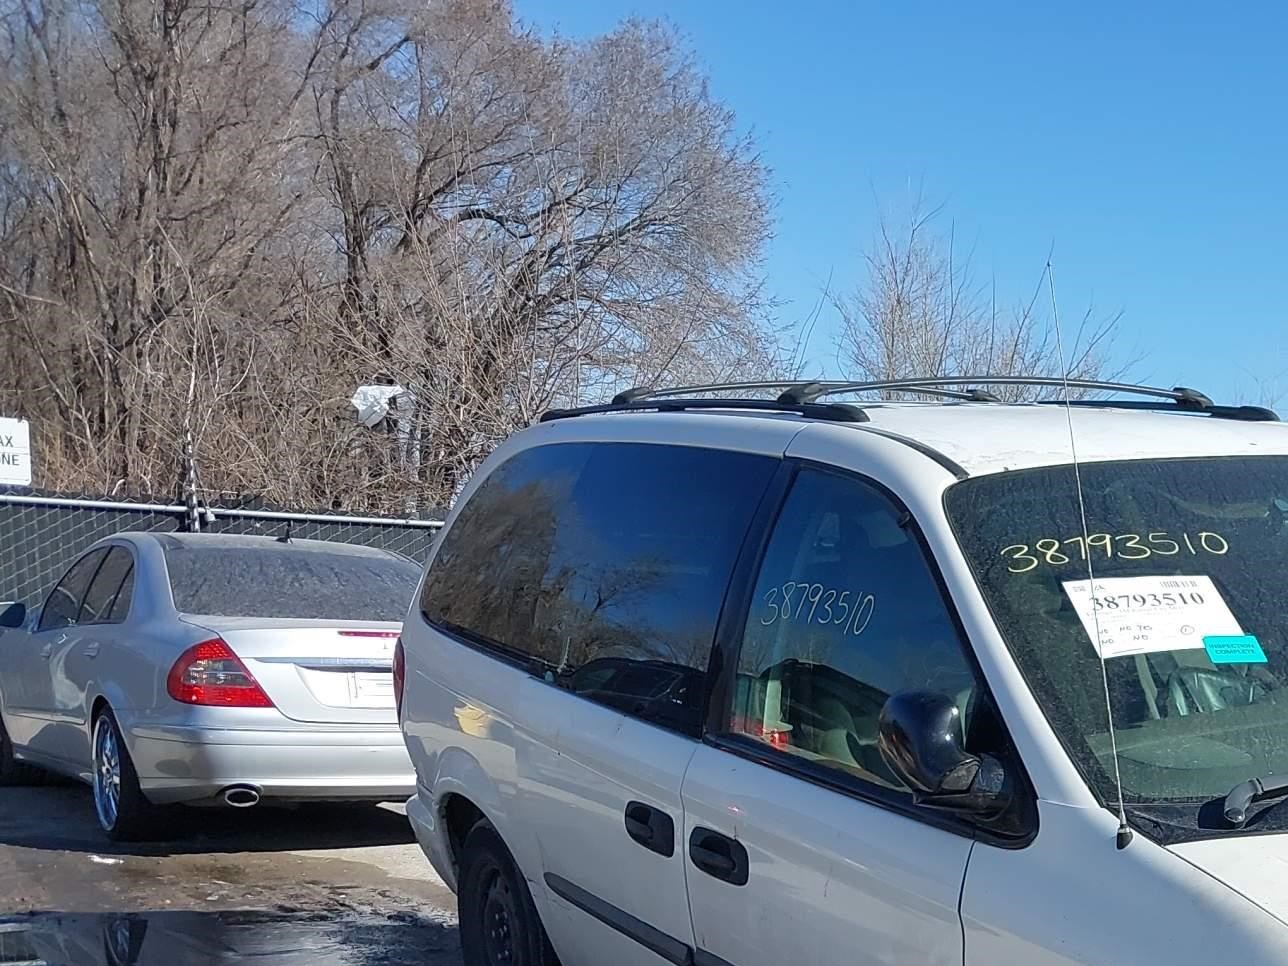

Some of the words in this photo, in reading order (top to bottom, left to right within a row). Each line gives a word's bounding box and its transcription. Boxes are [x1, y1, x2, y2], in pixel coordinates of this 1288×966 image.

[0, 453, 20, 466] NE
[1000, 531, 1229, 573] 38793510
[760, 581, 875, 636] 38793510
[1088, 591, 1205, 611] 38793510
